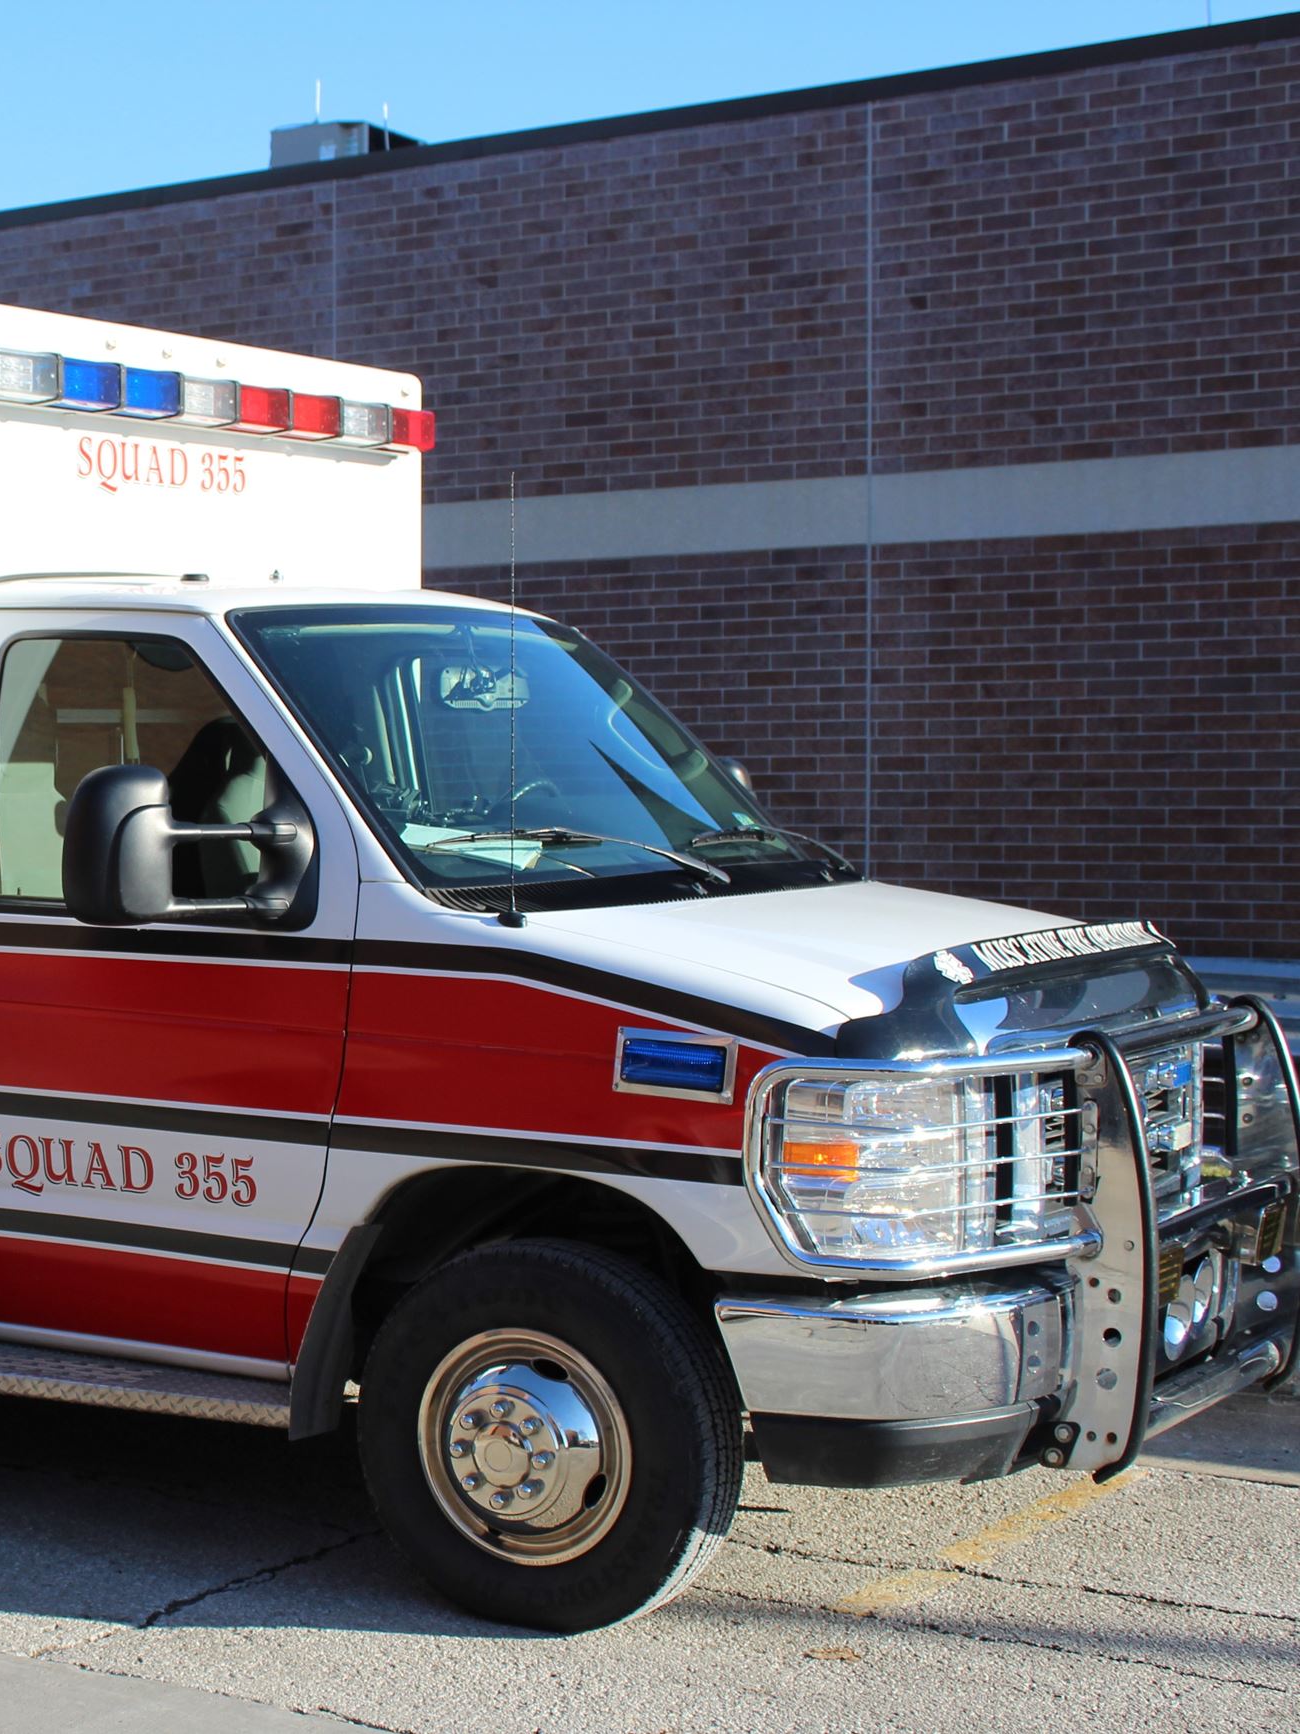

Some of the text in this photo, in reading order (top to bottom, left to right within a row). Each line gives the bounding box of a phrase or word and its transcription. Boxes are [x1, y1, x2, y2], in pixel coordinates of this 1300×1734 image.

[77, 436, 246, 495] SQUAD 355
[971, 930, 1074, 972] MUSCATINE
[175, 1152, 257, 1206] 355
